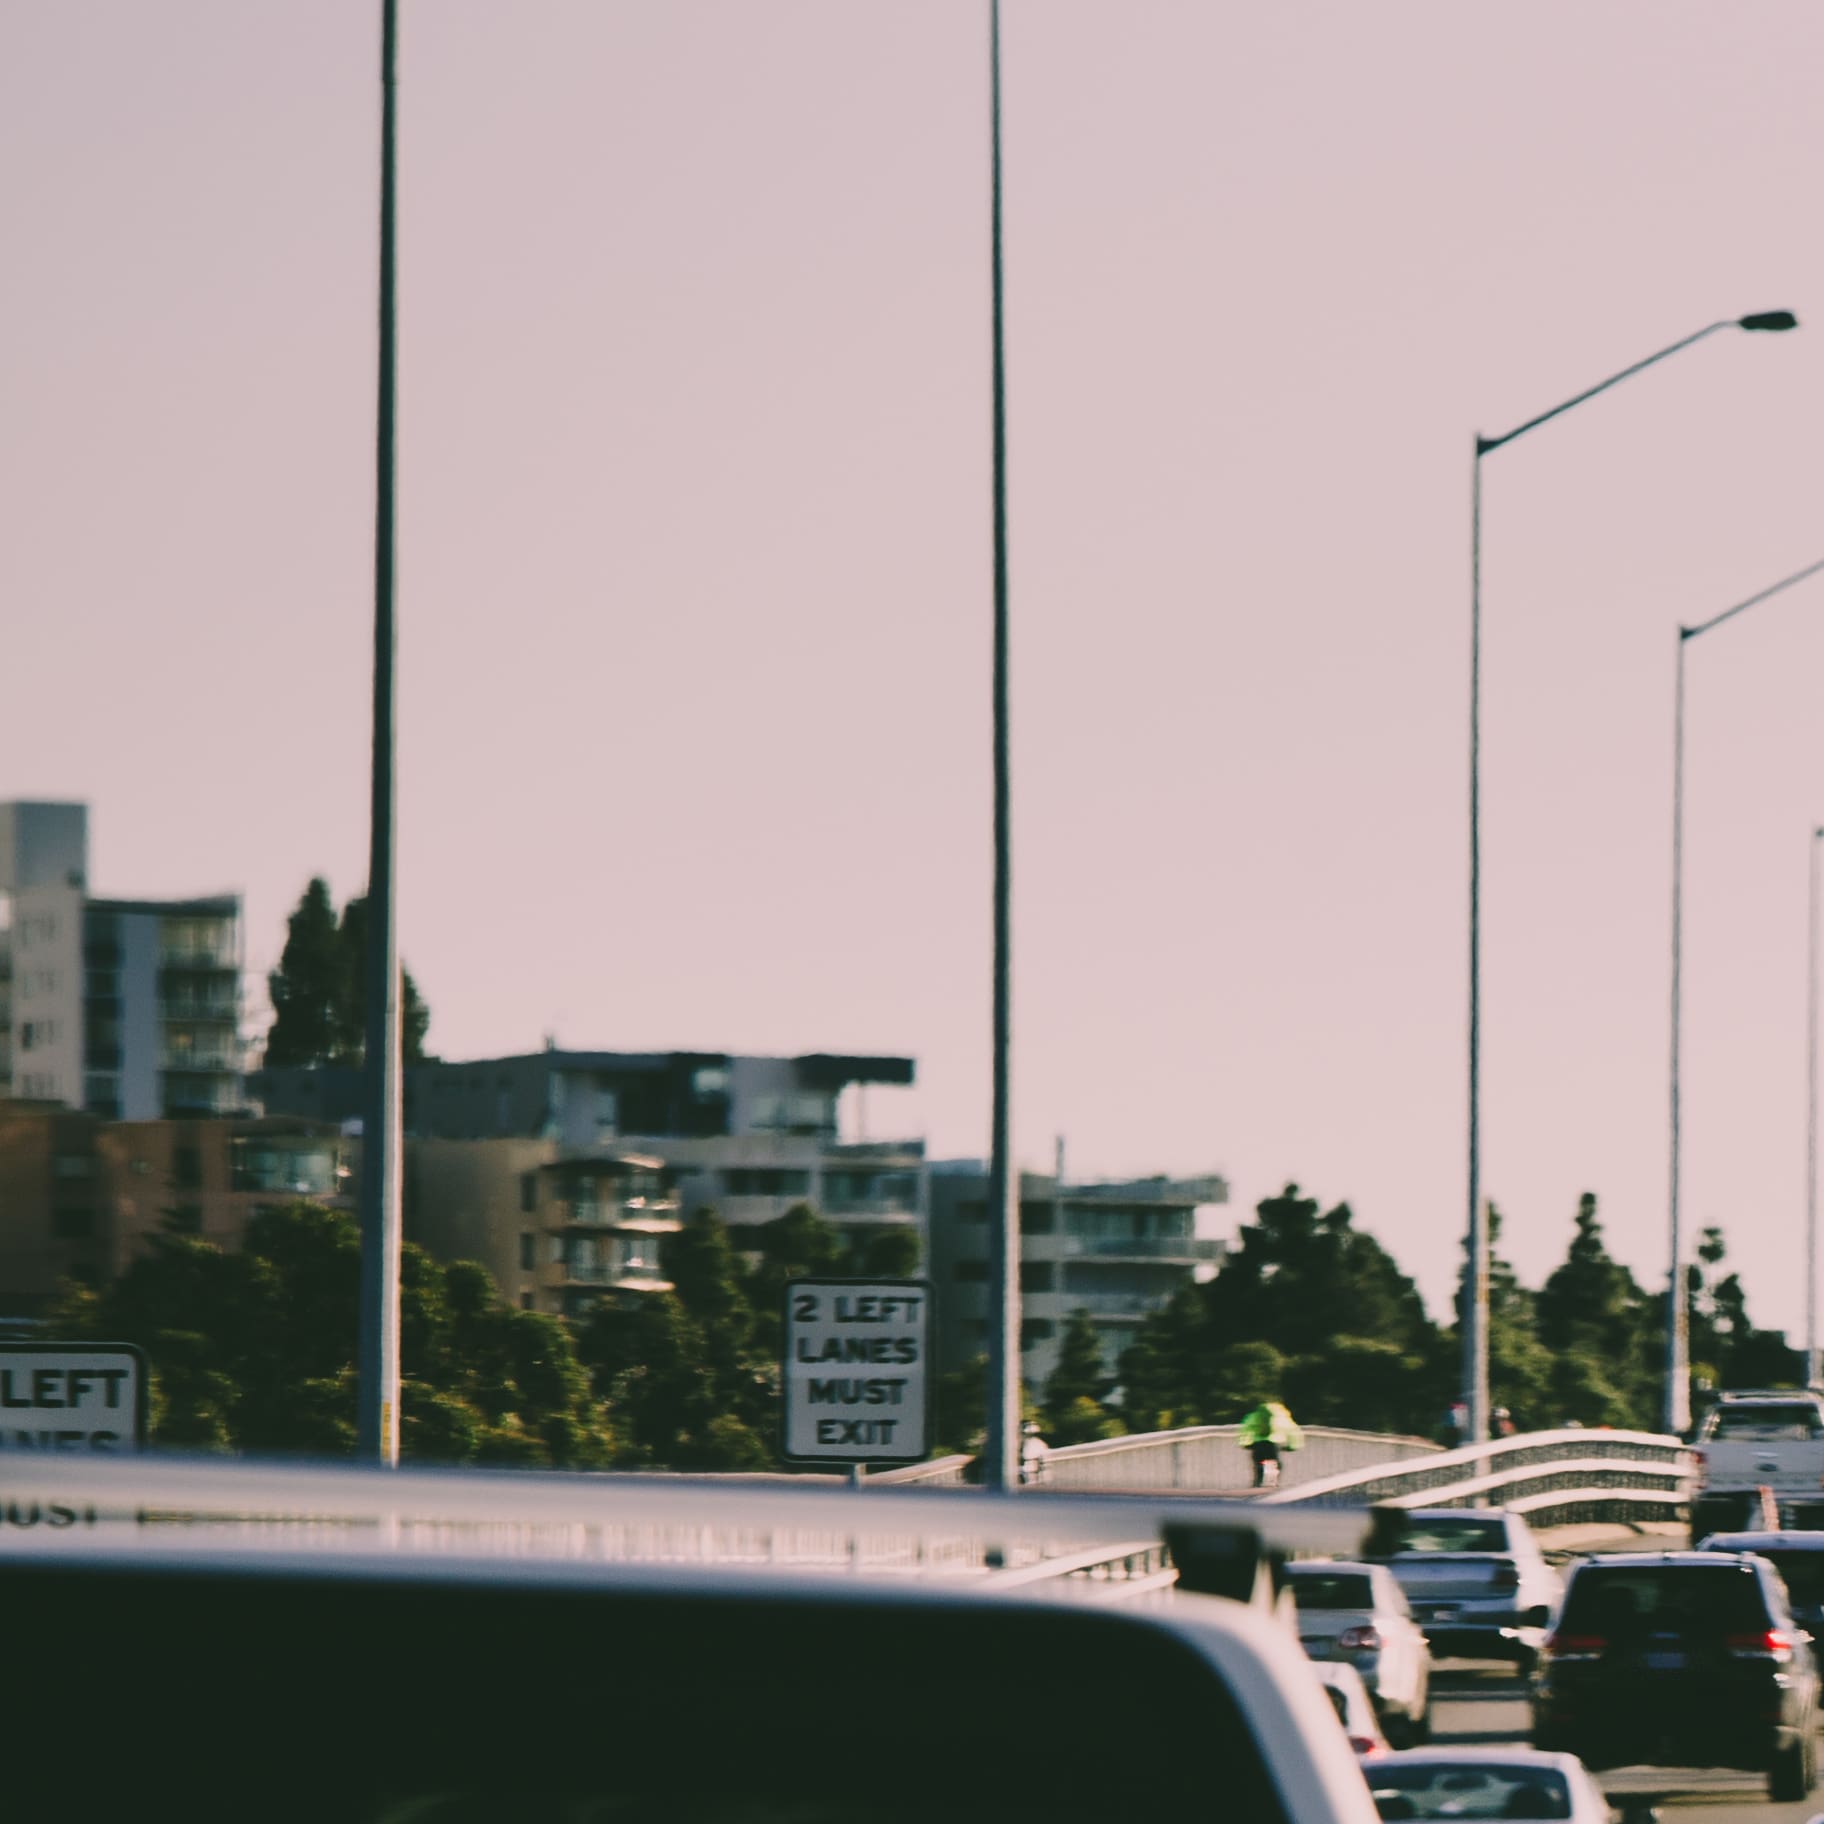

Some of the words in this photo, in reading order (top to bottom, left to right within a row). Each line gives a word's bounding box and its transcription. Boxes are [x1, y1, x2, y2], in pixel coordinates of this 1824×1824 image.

[793, 1294, 820, 1322] 2
[834, 1295, 923, 1323] LEFT
[797, 1337, 919, 1364] LANES
[1, 1369, 130, 1408] LEFT
[807, 1378, 908, 1404] MUST
[816, 1419, 899, 1445] EXIT
